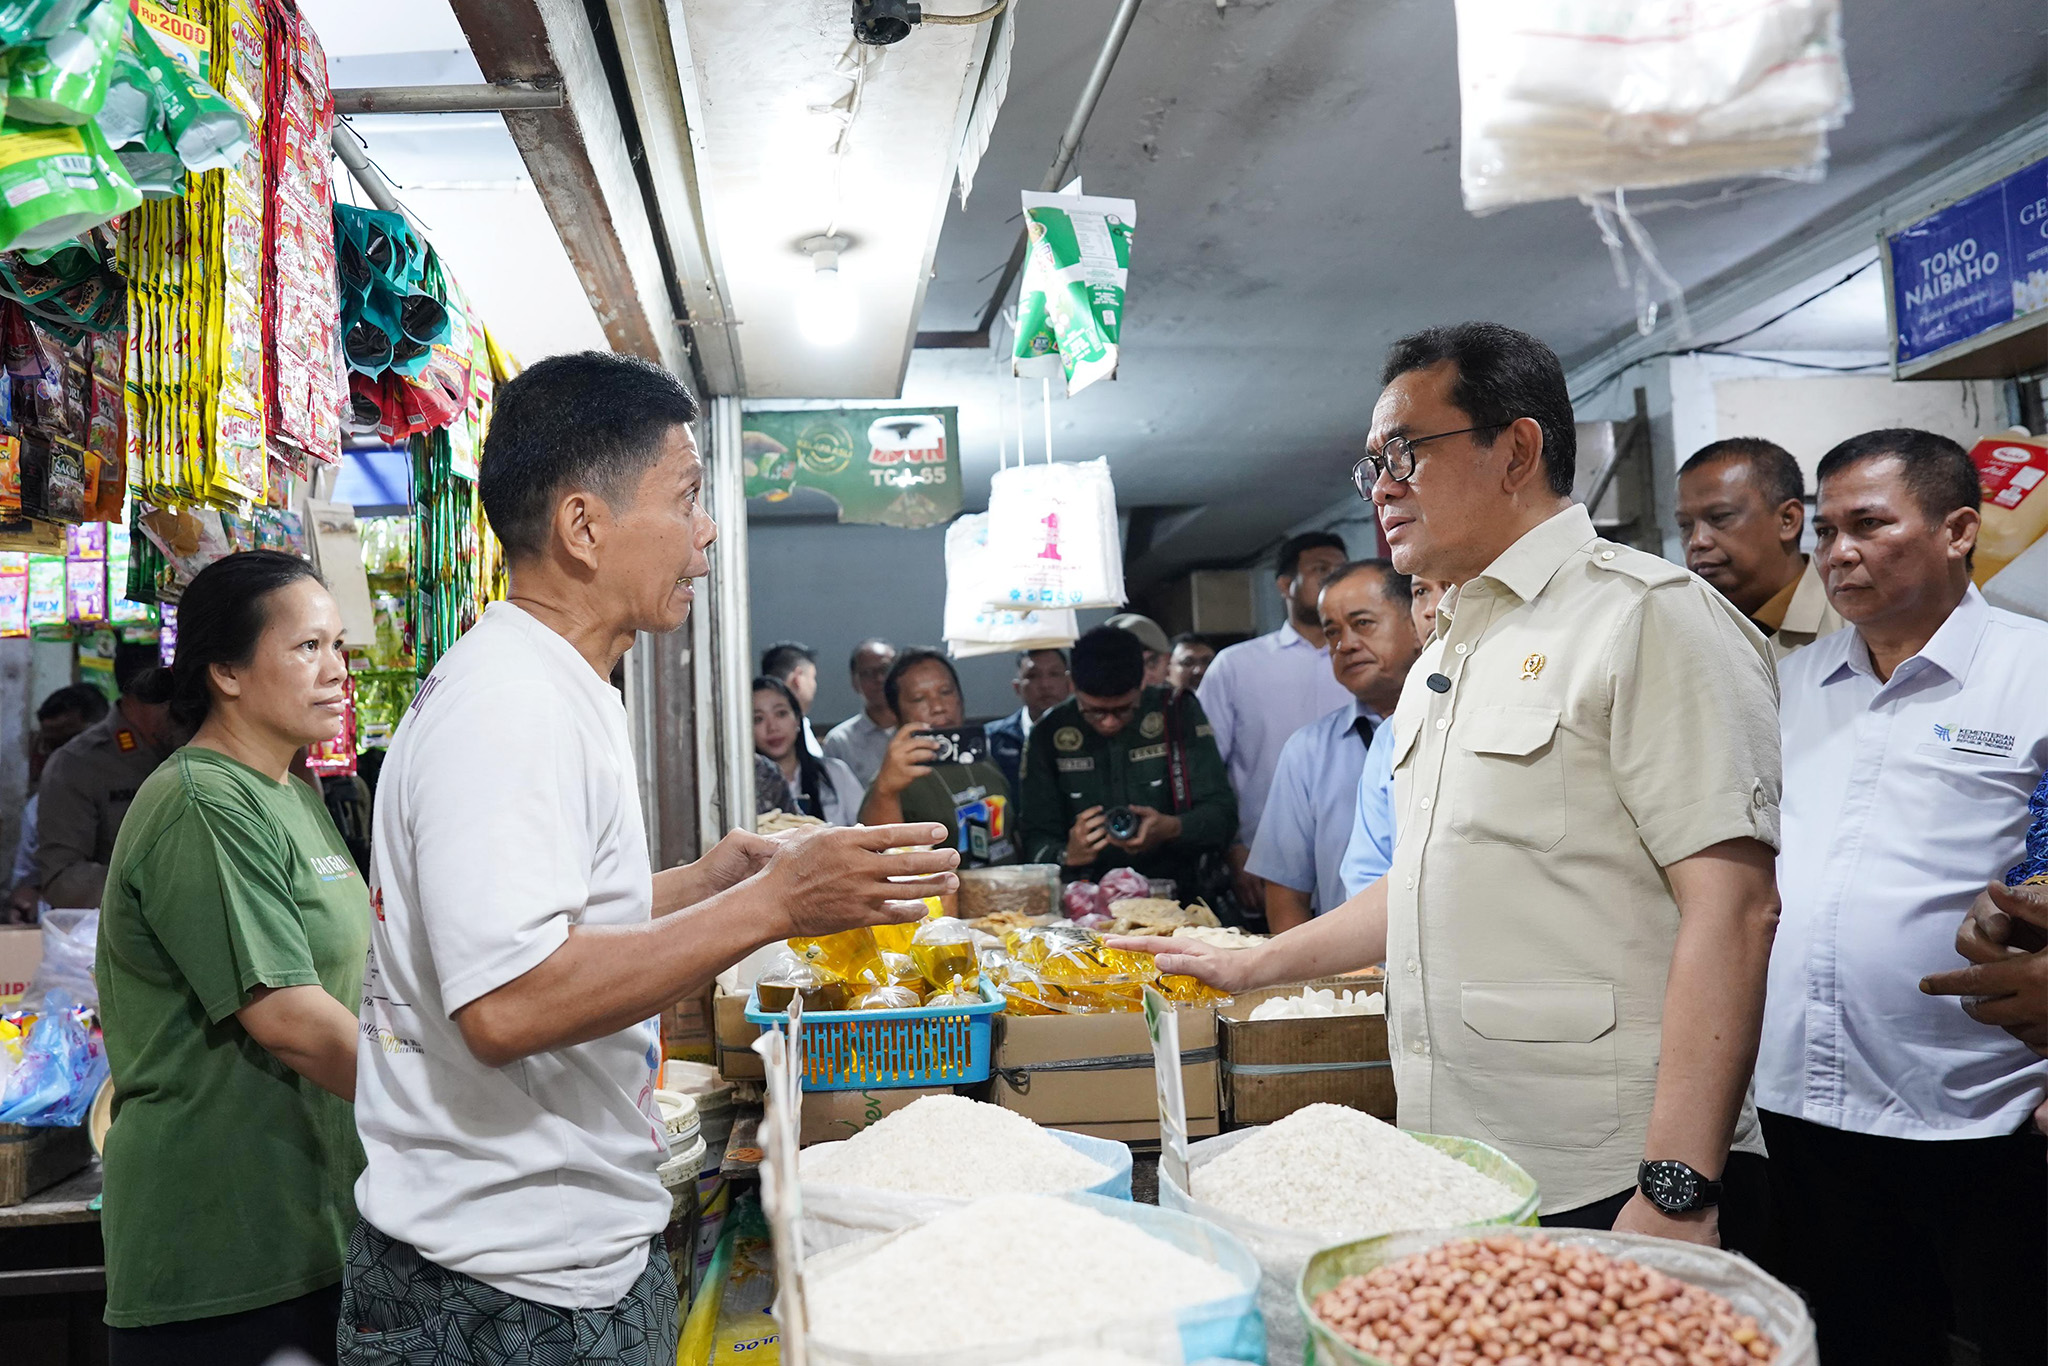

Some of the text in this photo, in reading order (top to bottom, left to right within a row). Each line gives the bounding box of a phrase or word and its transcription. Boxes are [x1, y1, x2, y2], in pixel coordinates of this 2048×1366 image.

[2020, 197, 2048, 225] GE
[1920, 238, 1977, 280] TOKO
[1905, 252, 1999, 311] NAIBAHO
[1957, 734, 2014, 747] PERDAGANGAN
[1959, 728, 2015, 741] KEMENTERIAN
[733, 1335, 780, 1353] ULOG
